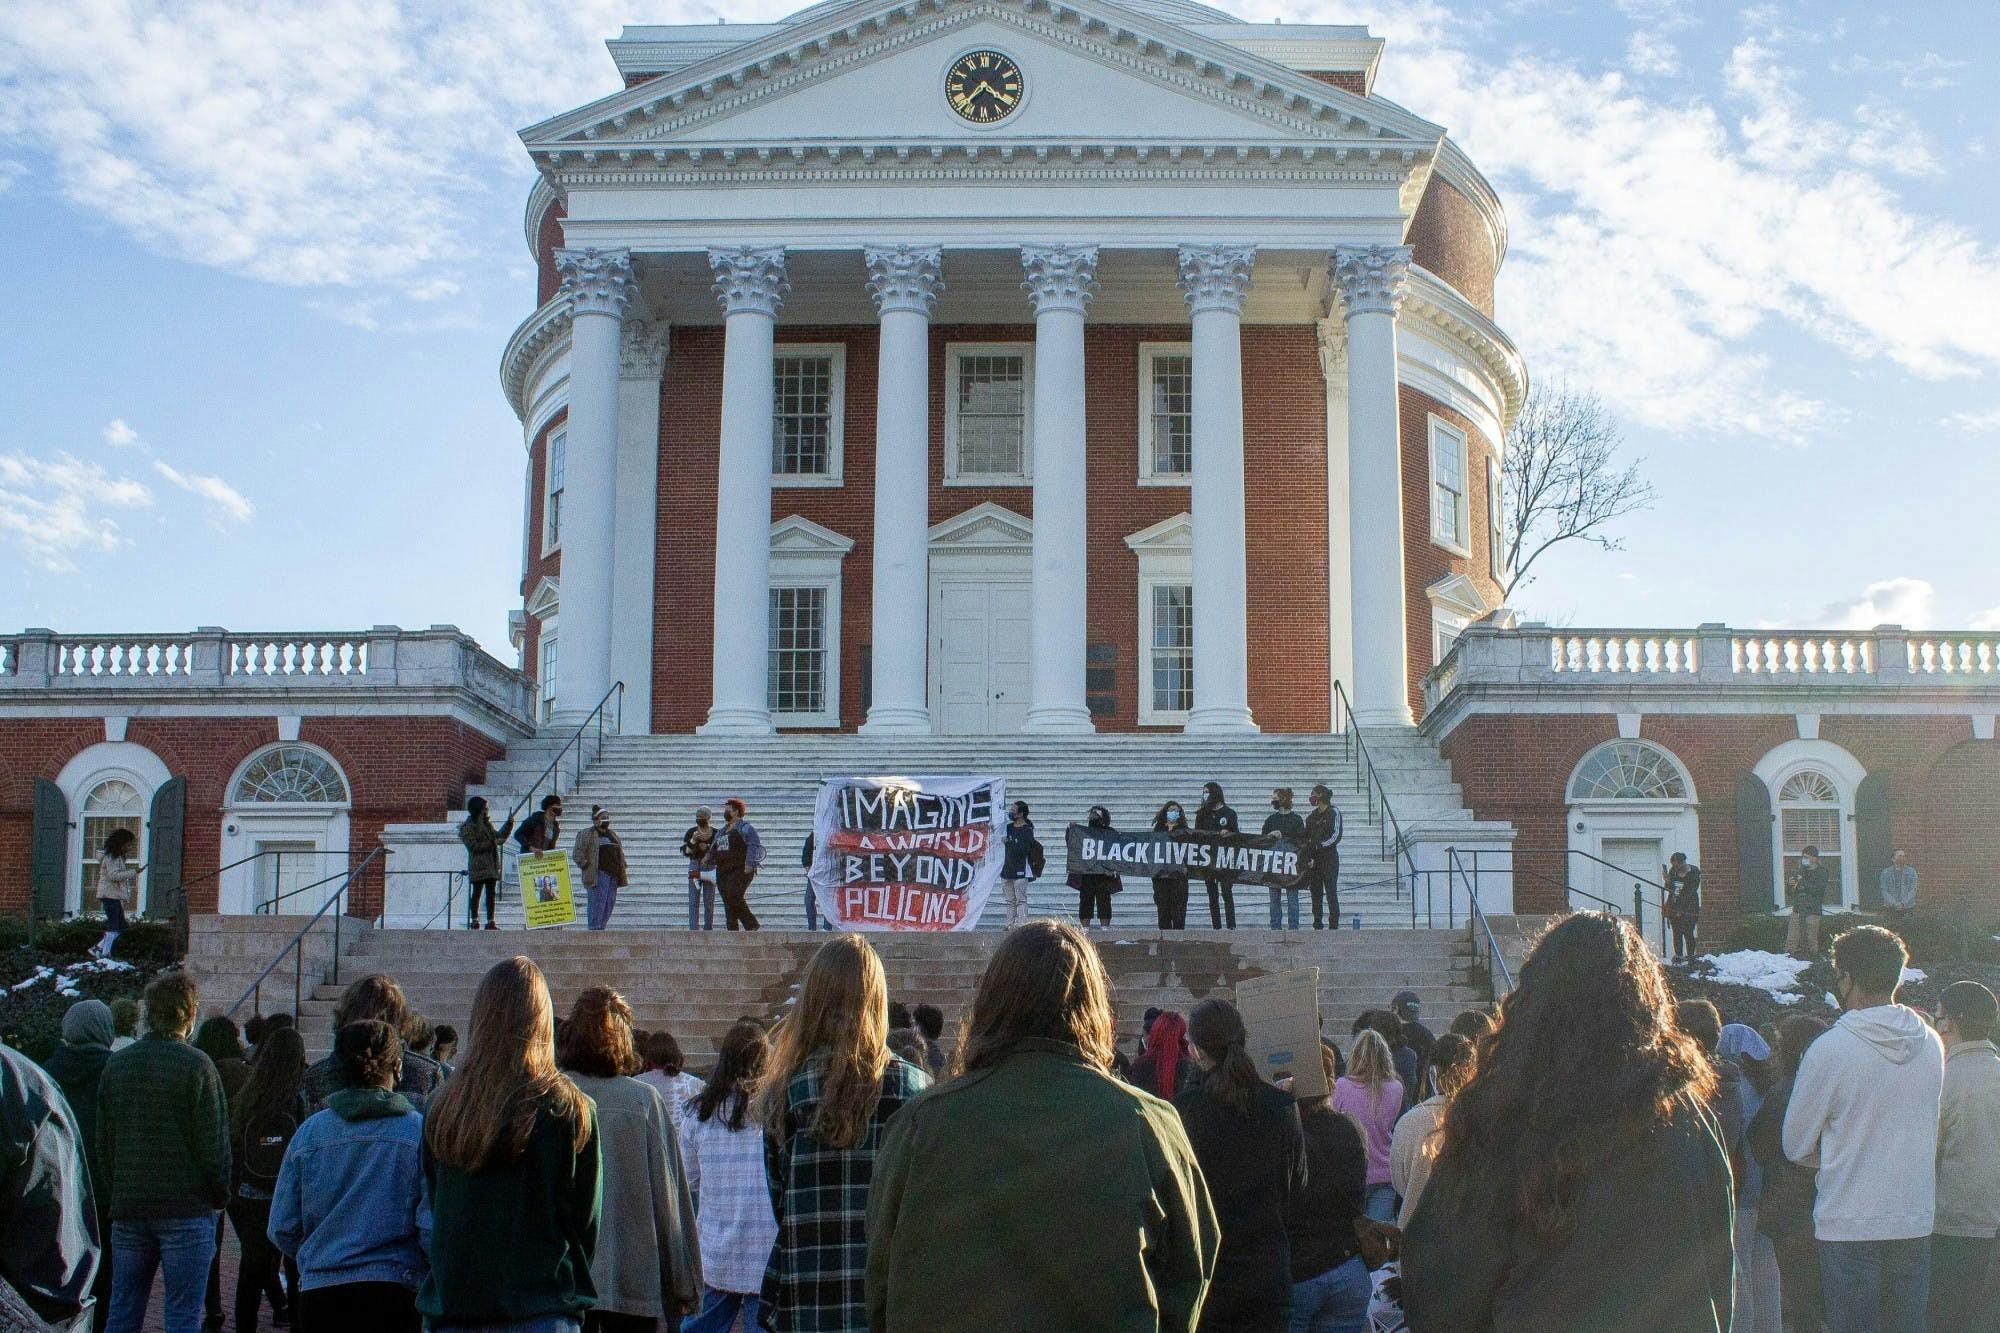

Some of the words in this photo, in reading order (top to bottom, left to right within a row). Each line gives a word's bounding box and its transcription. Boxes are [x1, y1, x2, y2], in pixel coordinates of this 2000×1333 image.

[841, 785, 992, 830] IMAGINE
[859, 836, 871, 849] A
[886, 828, 985, 853] WORLD
[1081, 838, 1149, 864] BLACK
[1153, 841, 1211, 867] LIVES
[1215, 846, 1298, 876] MATTER
[845, 853, 975, 890] BEYOND
[845, 885, 959, 924] POLICING
